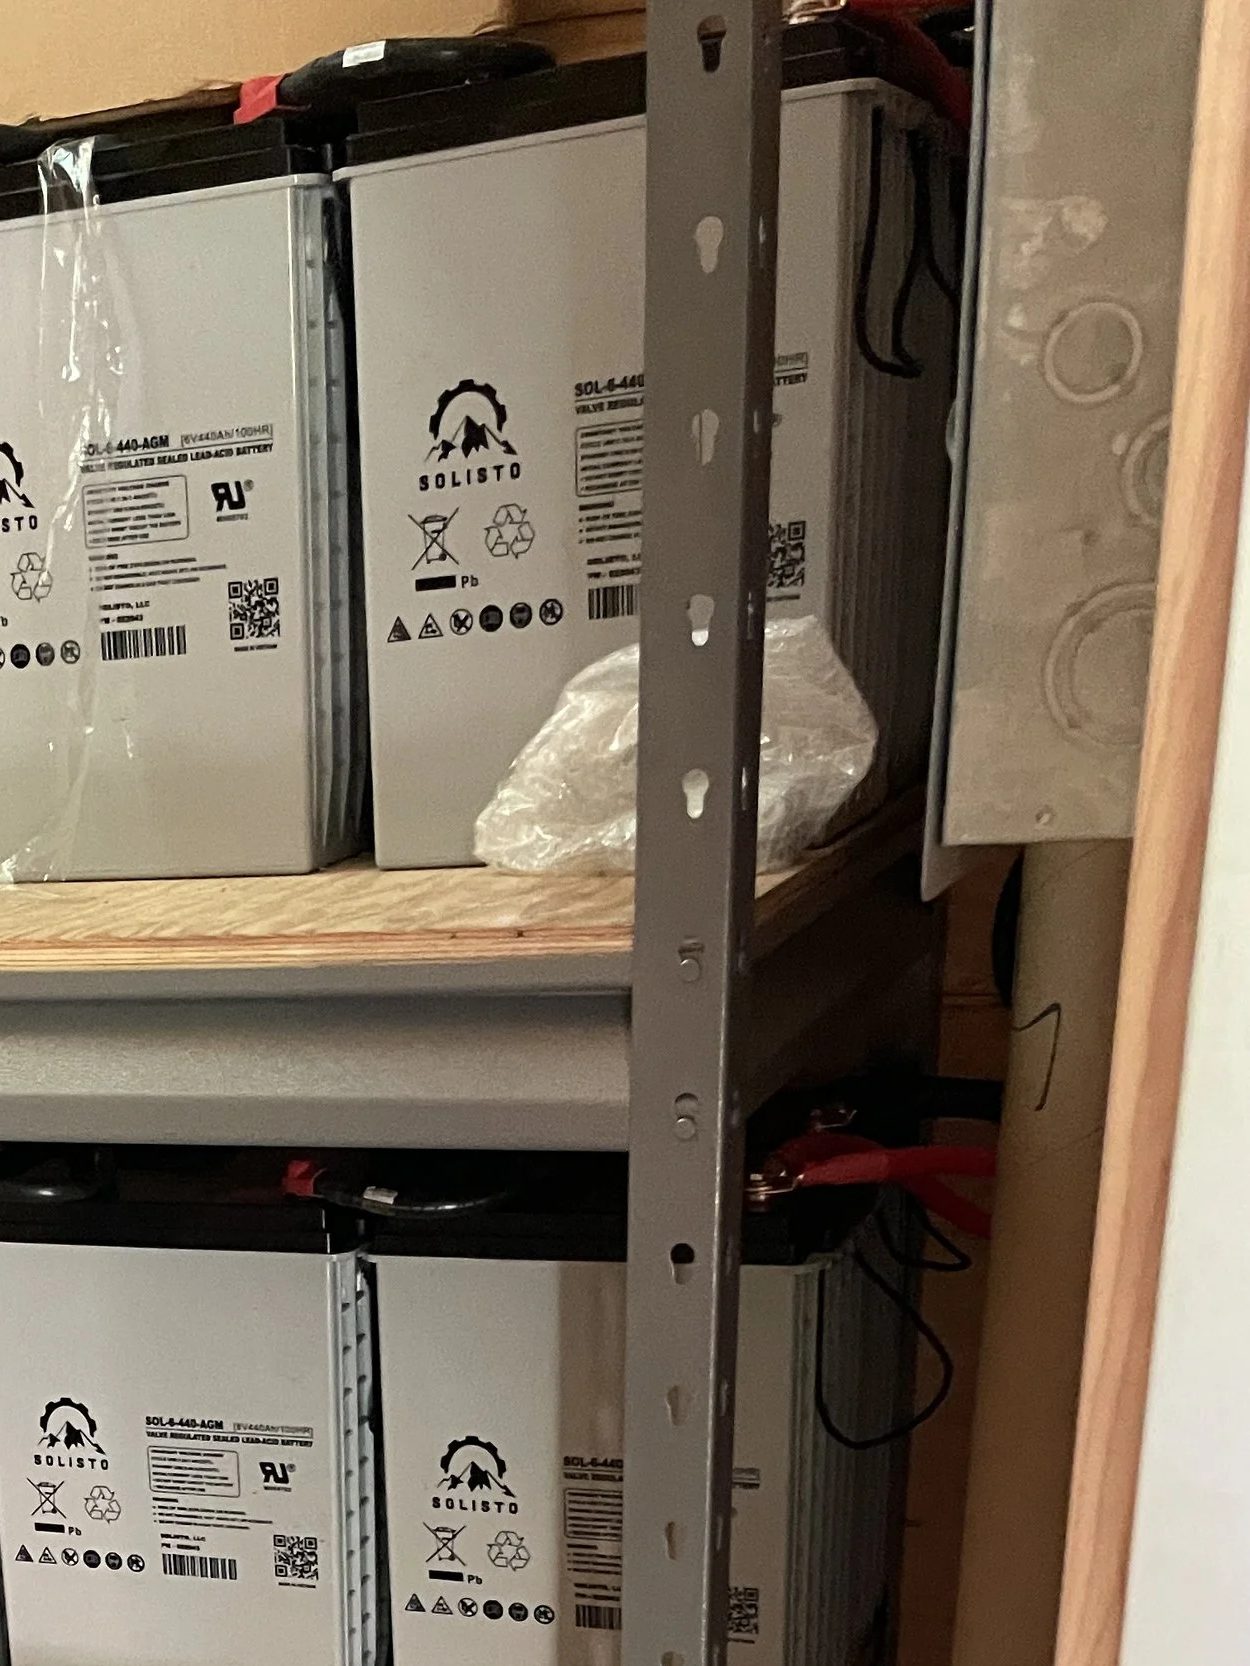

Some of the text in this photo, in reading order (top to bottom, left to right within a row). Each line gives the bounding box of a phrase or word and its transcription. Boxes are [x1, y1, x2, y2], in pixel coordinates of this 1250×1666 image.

[574, 373, 644, 397] SOL-6-440
[774, 372, 808, 387] TTERY
[156, 452, 189, 466] SEALED
[190, 447, 234, 462] LEAD-ACID
[235, 442, 274, 458] BATTERY
[418, 461, 522, 492] SOLISTO
[460, 575, 479, 589] Pb
[145, 1415, 224, 1431] SOL-6-440-AGM
[34, 1454, 109, 1471] SOLISTO
[563, 1456, 624, 1470] SOL-6-440
[432, 1496, 519, 1515] SOLISTO
[467, 1574, 483, 1585] Pb
